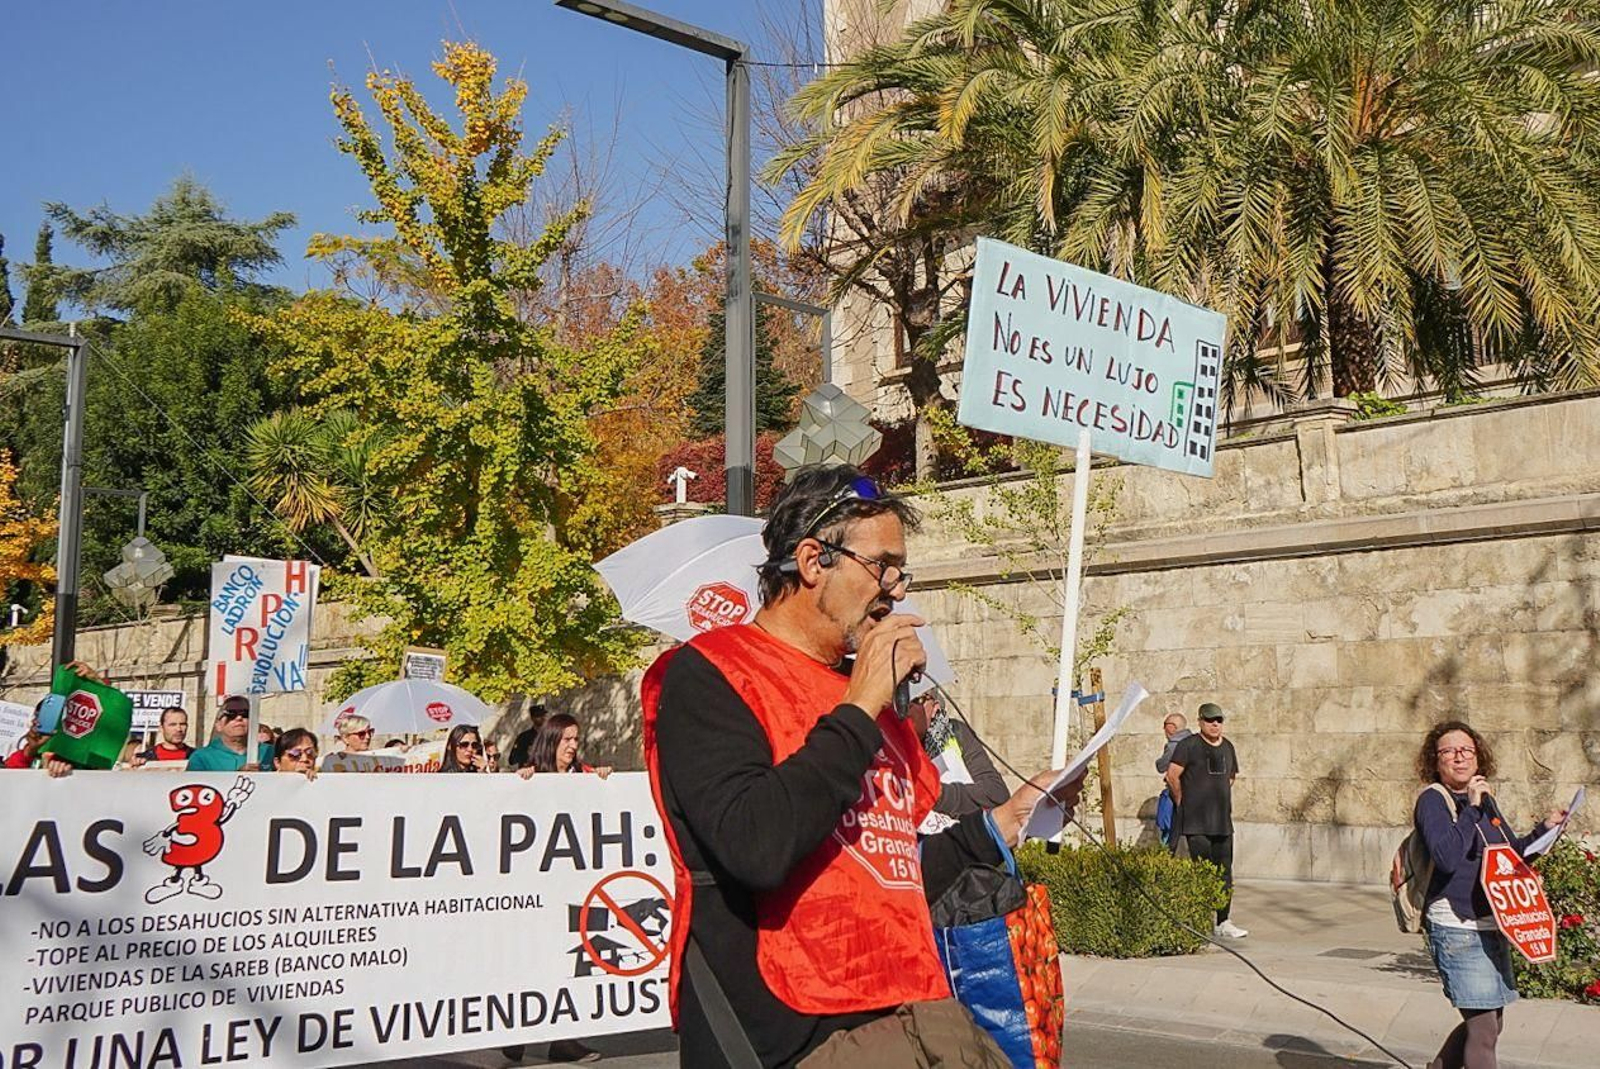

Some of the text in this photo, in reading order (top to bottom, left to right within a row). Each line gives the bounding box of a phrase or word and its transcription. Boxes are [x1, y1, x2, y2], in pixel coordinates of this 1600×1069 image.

[997, 261, 1027, 301] LA
[1029, 336, 1054, 365] ES
[1065, 346, 1093, 375] UN
[1105, 356, 1159, 394] LUJO
[992, 369, 1027, 413] ES
[211, 564, 254, 614] BANCO
[698, 589, 746, 619] STOP
[67, 699, 97, 720] STOP
[142, 692, 181, 708] VENDE
[857, 770, 915, 815] TOP
[0, 818, 125, 897] AS
[265, 817, 362, 885] DE
[391, 814, 474, 878] LA
[499, 811, 657, 875] PAH:
[1488, 877, 1539, 911] STOP
[31, 894, 544, 940] -NO A LOS DESAHUCIOS SIN ALTERNATIVA HABITACIONAL
[1514, 925, 1551, 943] Granada
[27, 926, 377, 967] -TOPE AL PRECIO DE LOS ALQUILERES
[23, 946, 409, 996] -VIVIENDAS DE LA SAREB (BANCO MALO)
[25, 978, 344, 1025] PARQUE PUBLICO DE VIVIENDAS
[66, 1027, 183, 1069] UNA
[200, 1016, 283, 1066] LEY
[297, 1008, 355, 1054] DE
[369, 987, 580, 1045] VIVIENDA
